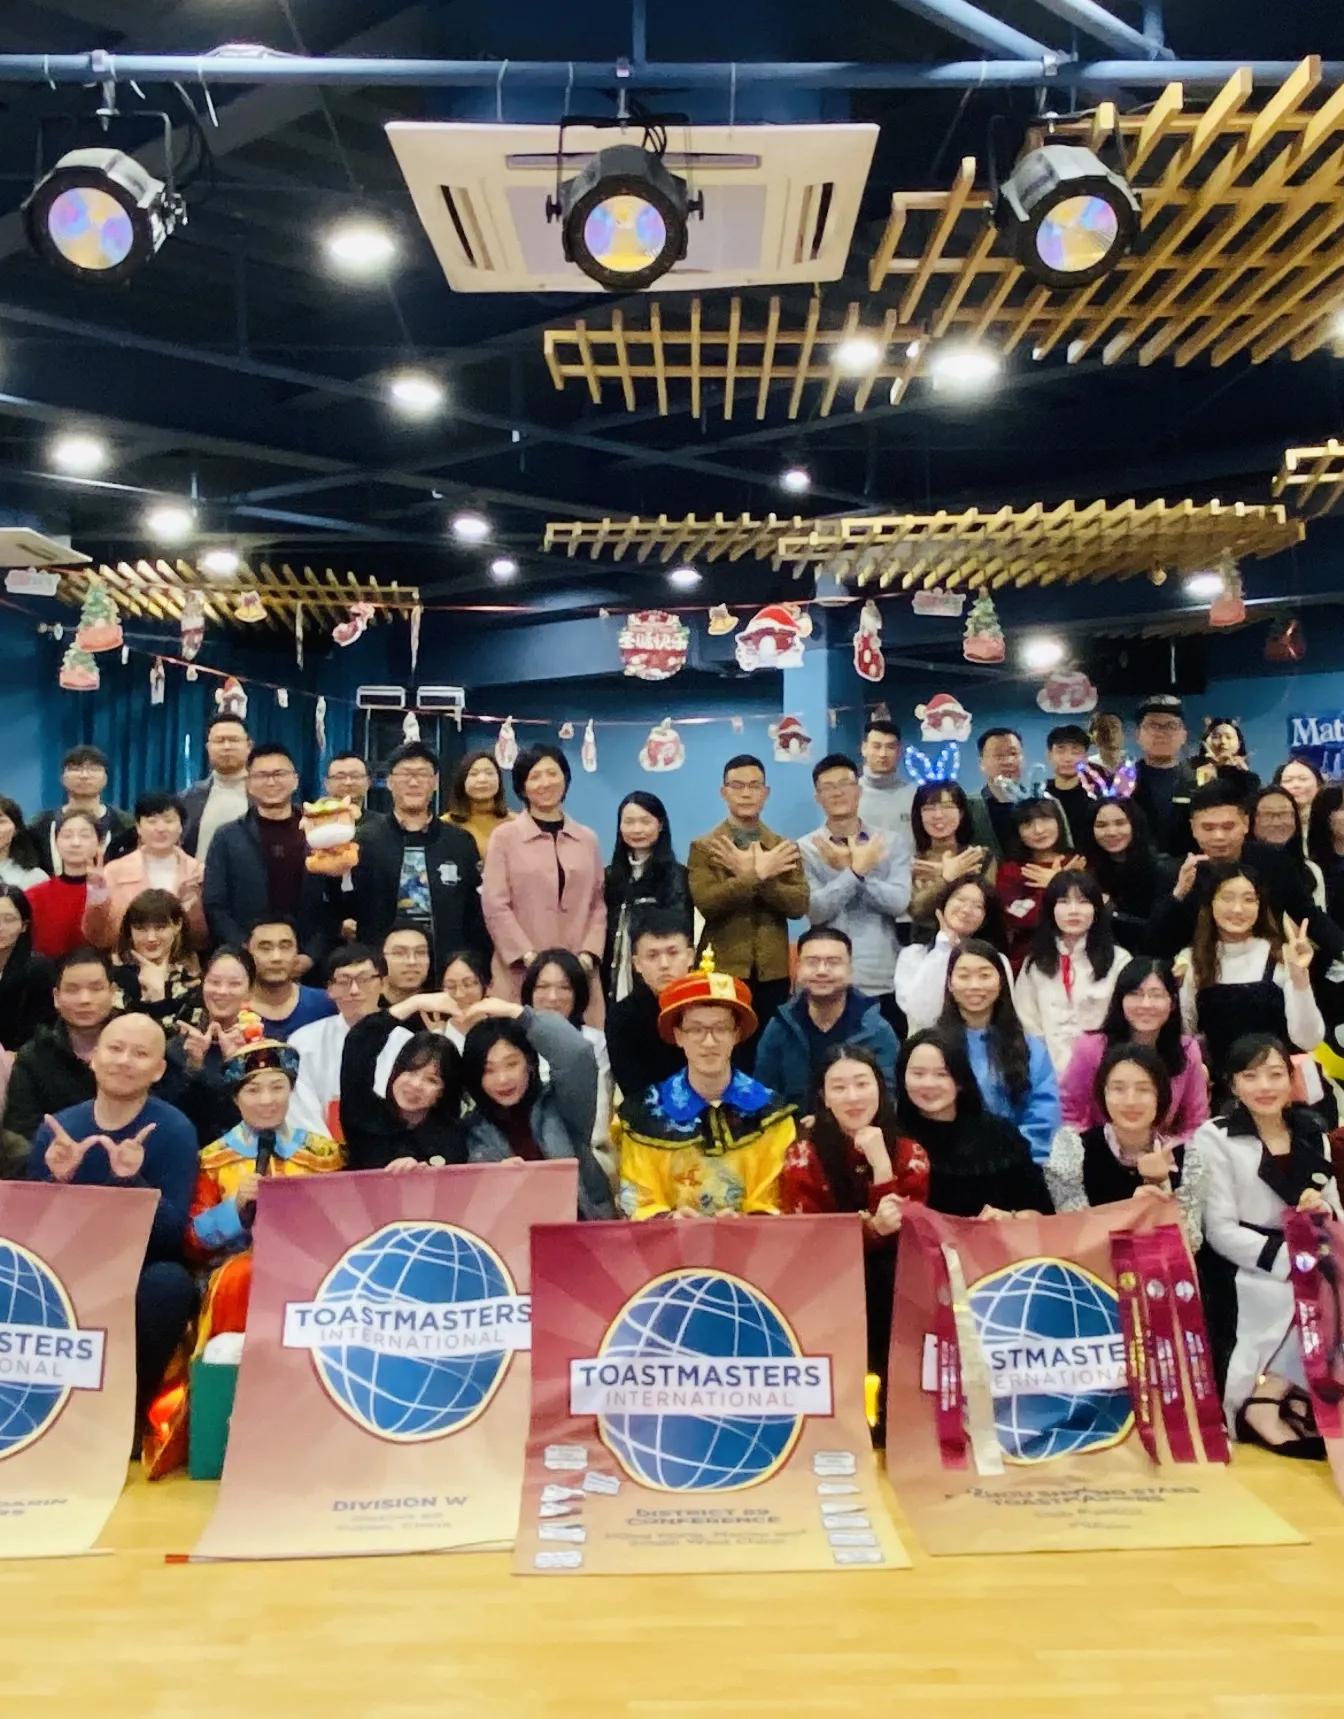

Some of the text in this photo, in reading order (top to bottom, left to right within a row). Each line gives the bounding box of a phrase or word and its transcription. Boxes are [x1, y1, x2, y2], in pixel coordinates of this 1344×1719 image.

[295, 1303, 532, 1331] TOASTMASTERS
[320, 1327, 505, 1350] INTERNATIONAL
[991, 1342, 1126, 1370] STMASTE
[580, 1364, 821, 1387] TOASTMASTERS
[993, 1365, 1129, 1391] ERNATIONA
[605, 1390, 795, 1408] INTERNATIONAL
[332, 1497, 438, 1512] DIVISION
